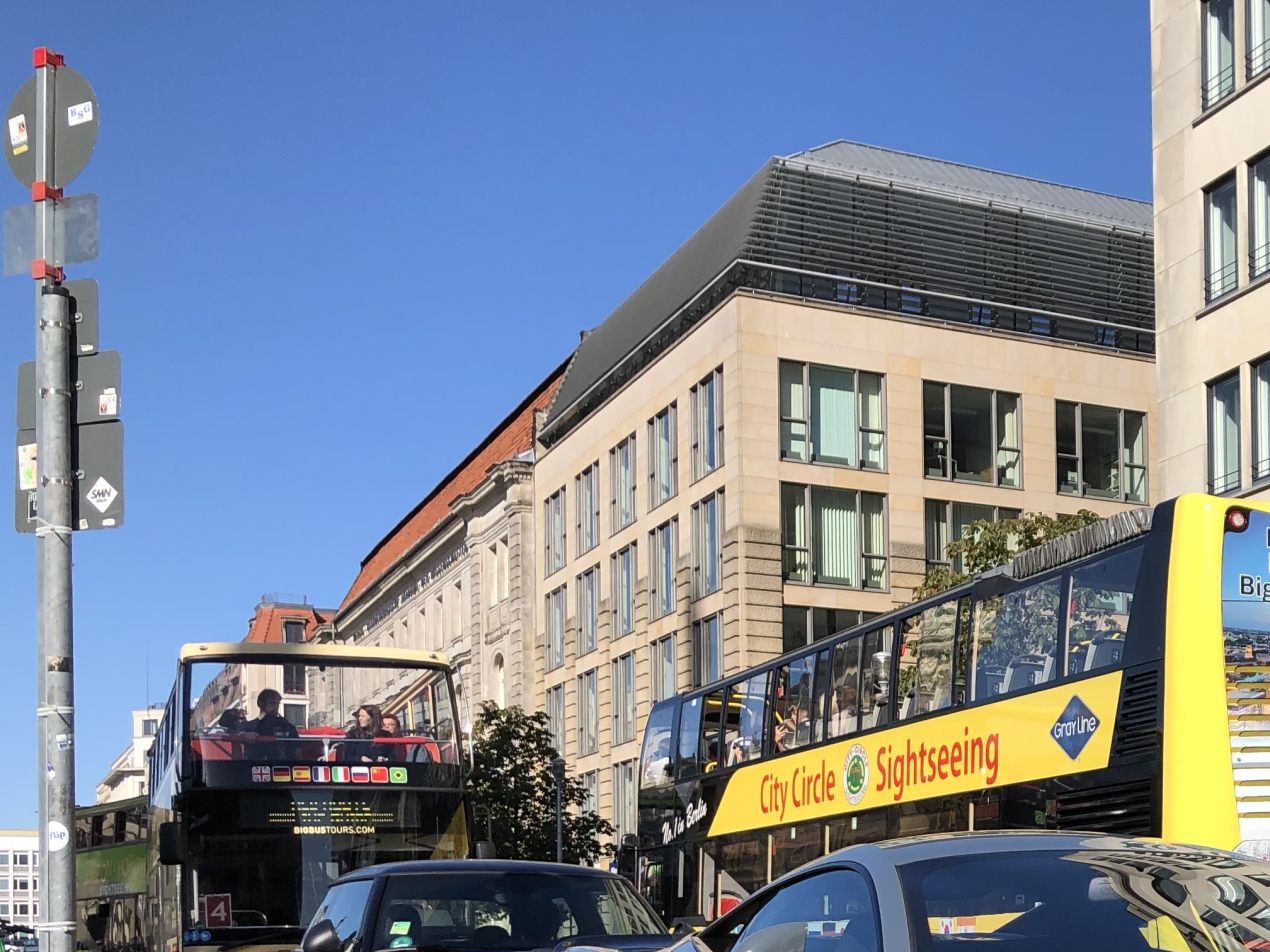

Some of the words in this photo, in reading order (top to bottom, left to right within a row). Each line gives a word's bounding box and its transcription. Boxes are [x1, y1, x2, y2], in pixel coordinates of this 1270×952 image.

[70, 104, 91, 120] BSG
[91, 488, 112, 500] SMN
[1053, 720, 1076, 739] Gray
[760, 773, 788, 822] City
[792, 759, 836, 808] Circle
[876, 726, 999, 802] Sightseeing
[686, 797, 707, 829] Berlin
[49, 829, 66, 840] flip
[293, 825, 375, 835] BIGBUSTOURS.COM
[210, 900, 227, 921] 4
